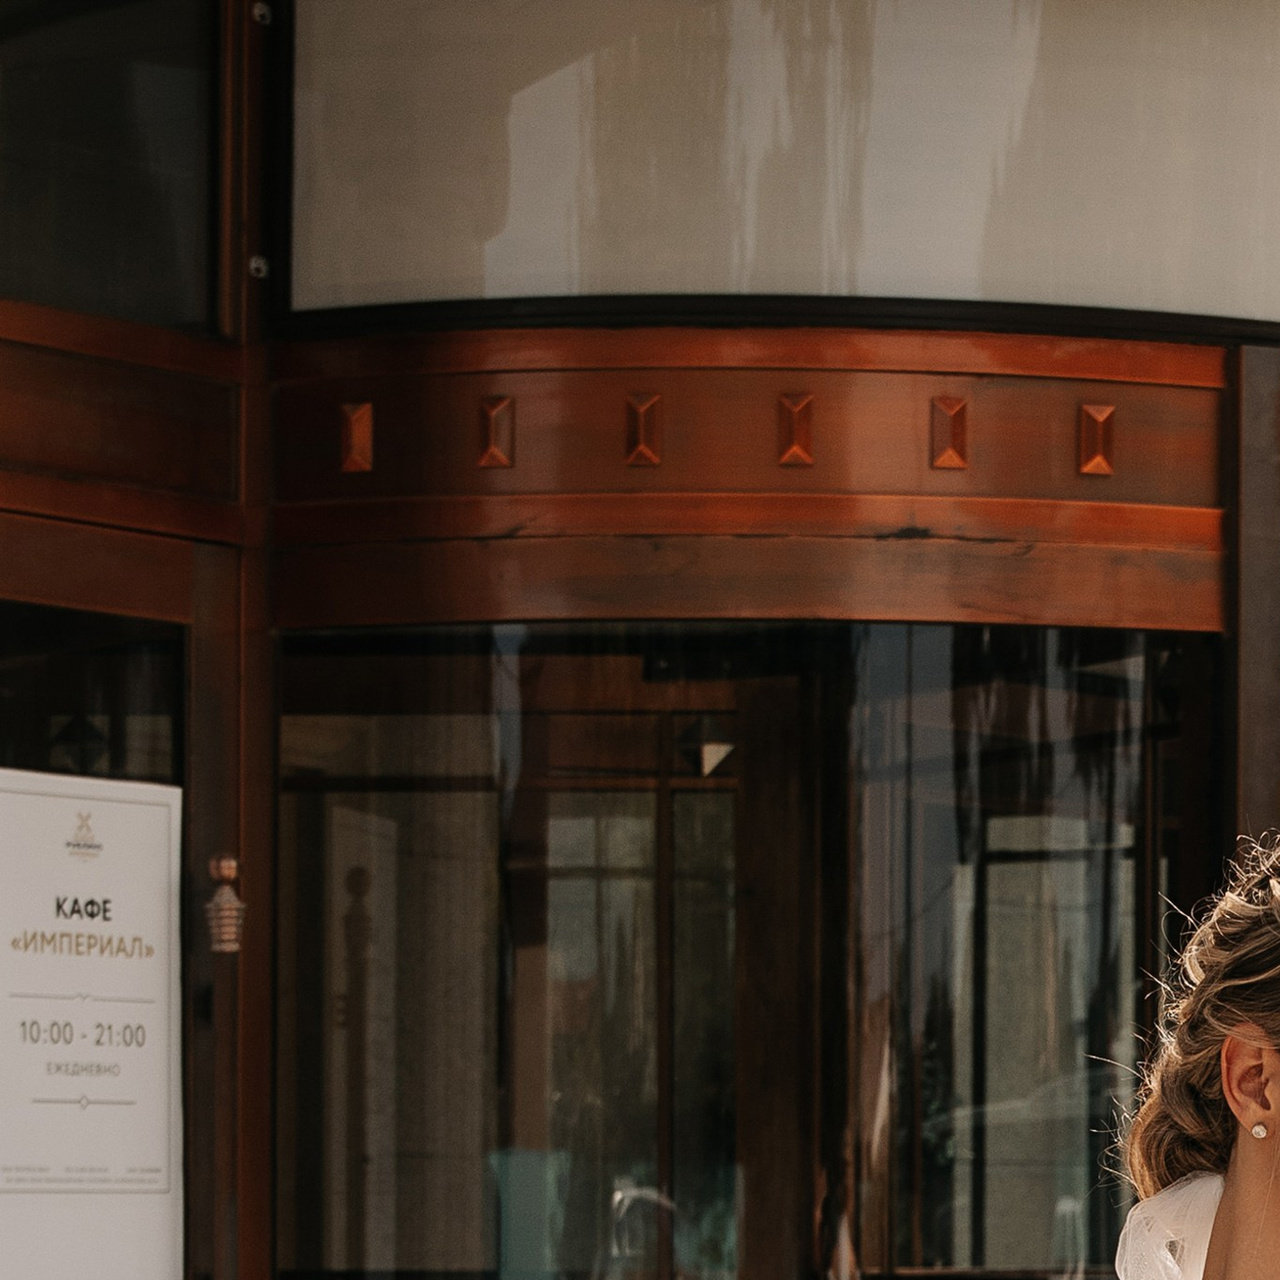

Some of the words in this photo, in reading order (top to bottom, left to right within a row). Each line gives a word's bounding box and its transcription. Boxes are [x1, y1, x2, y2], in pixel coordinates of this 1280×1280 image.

[55, 897, 112, 922] КАФЕ
[11, 930, 156, 960] «ИМПЕРИАЛ»
[20, 1020, 74, 1045] 10:00
[95, 1022, 147, 1047] 21:00
[46, 1061, 121, 1077] ЕЖЕДНЕВНО
